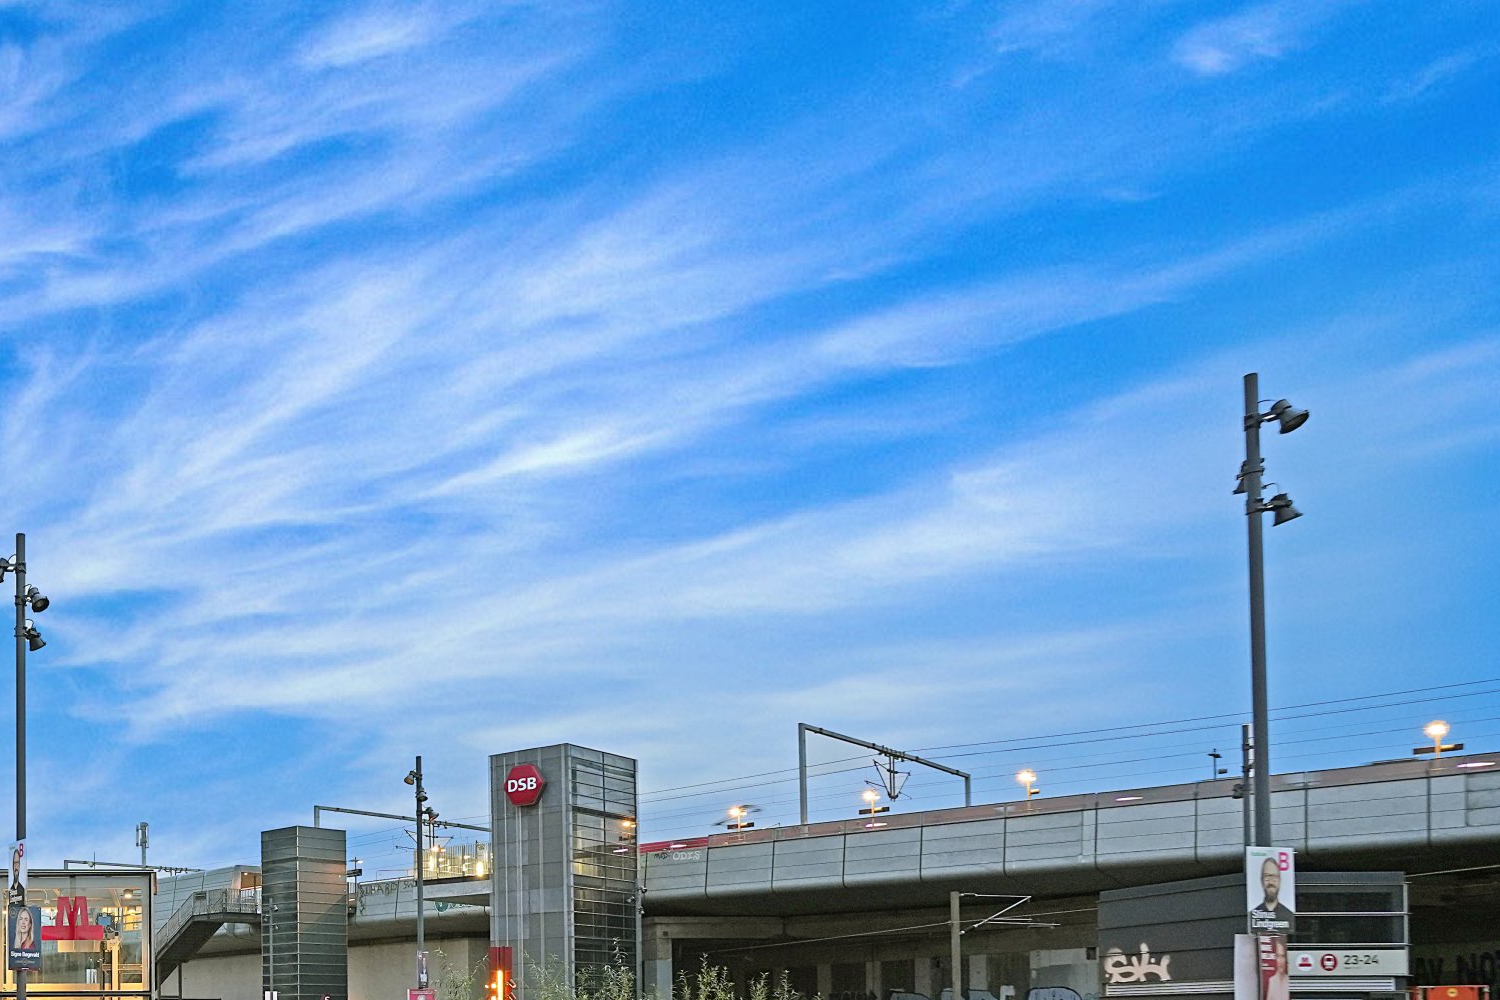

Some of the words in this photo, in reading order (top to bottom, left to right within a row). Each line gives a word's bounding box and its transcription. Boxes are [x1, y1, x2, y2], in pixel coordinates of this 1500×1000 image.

[507, 776, 537, 793] DSB
[1278, 851, 1290, 872] B
[1251, 909, 1276, 919] Stinus
[1251, 918, 1290, 930] Lindgreen
[1344, 954, 1379, 965] 23-24
